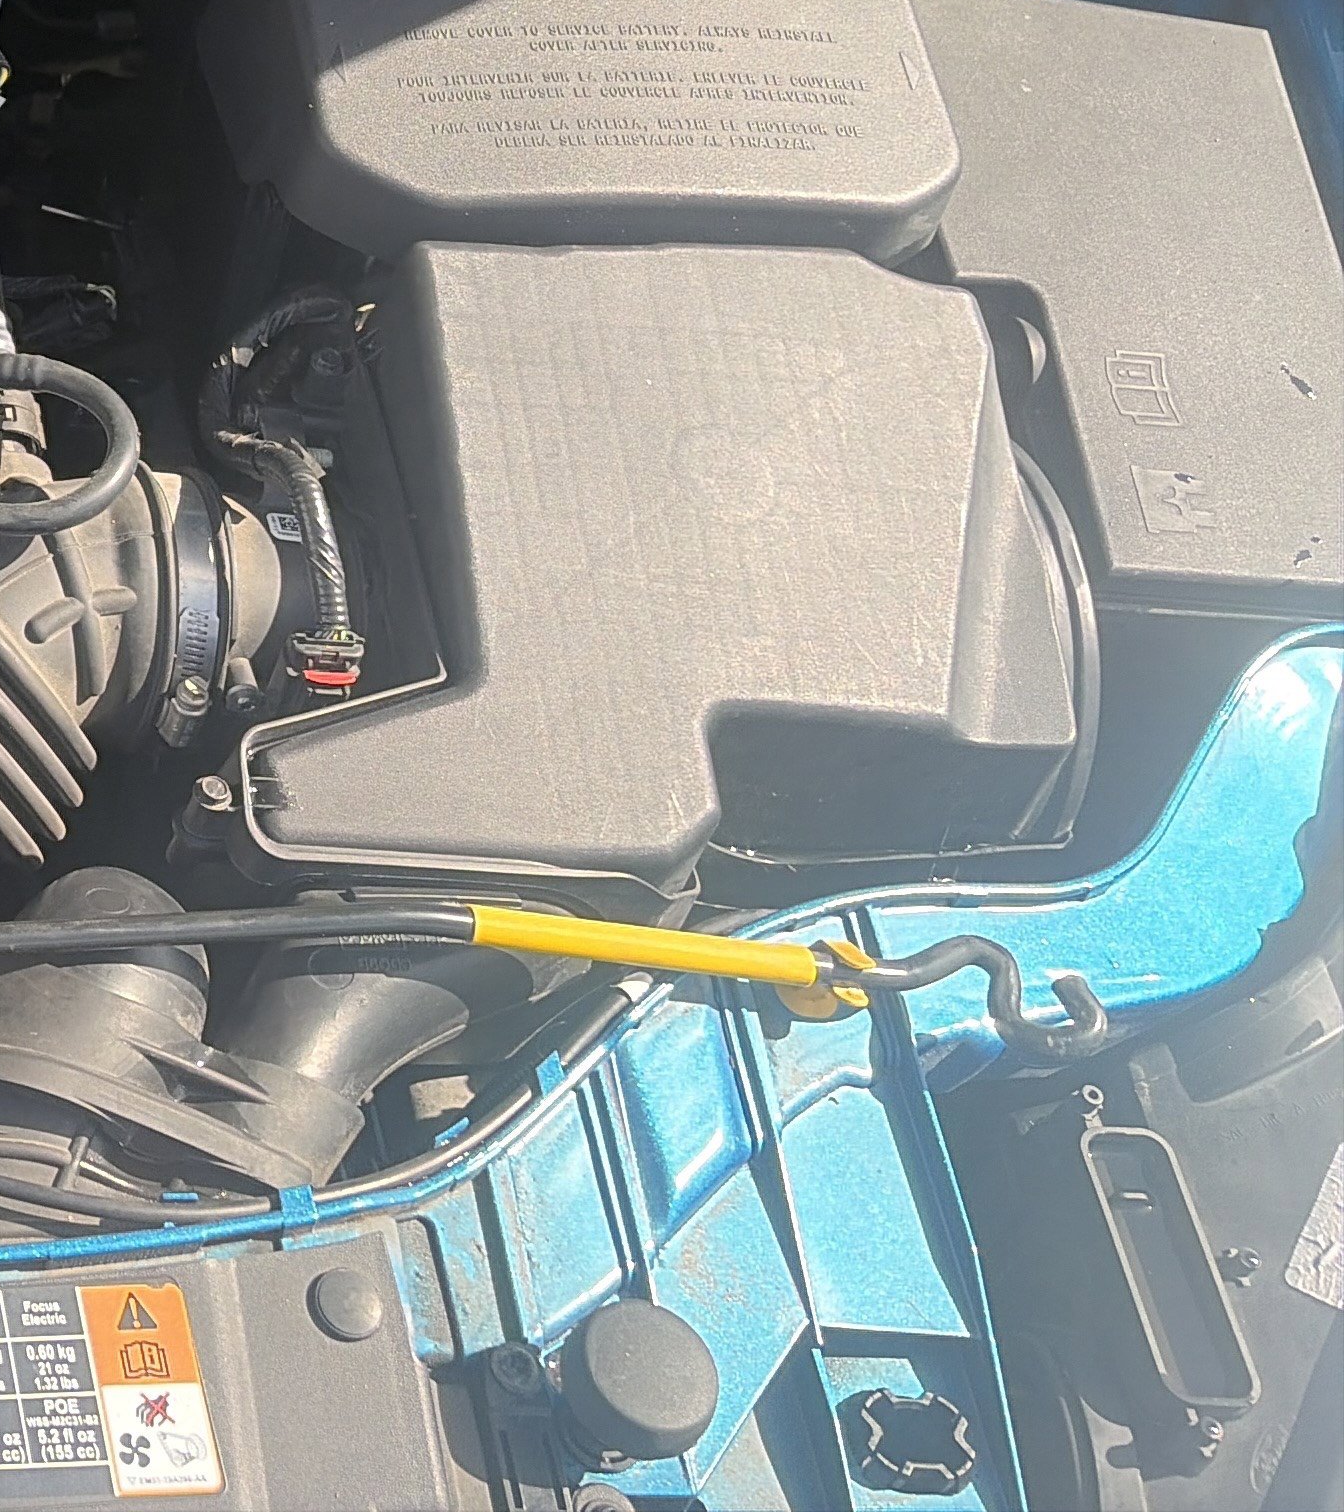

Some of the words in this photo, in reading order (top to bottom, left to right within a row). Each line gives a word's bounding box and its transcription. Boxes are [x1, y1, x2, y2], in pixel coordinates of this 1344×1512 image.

[404, 28, 457, 41] REMOVE
[467, 26, 512, 38] COVER
[520, 25, 539, 36] TO
[548, 24, 607, 36] SERVICE
[698, 25, 750, 38] ALWAYS
[758, 27, 836, 43] REINSTALL
[529, 40, 574, 52] COVER
[583, 40, 628, 51] AFTER
[637, 40, 724, 53] SERVICING.
[397, 75, 434, 88] POUR
[444, 73, 534, 86] INTERVENIR
[542, 72, 570, 83] SUR
[578, 72, 597, 83] LA
[694, 72, 756, 85] ENLEVER
[762, 74, 783, 87] LE
[790, 76, 868, 92] COUVERCLE
[419, 89, 492, 103] TOUJOURS
[501, 87, 564, 100] REPOSER
[573, 88, 592, 98] LE
[600, 87, 681, 99] COUVERCLE
[742, 88, 854, 106] INTERVENTION.
[430, 122, 470, 135] PARA
[477, 119, 541, 132] REVISAR
[550, 119, 569, 131] LA
[657, 118, 712, 131] RETIRE
[720, 120, 741, 131] EL
[747, 120, 828, 135] PROTECTOR
[835, 124, 863, 138] QUE
[558, 135, 585, 146] SER
[595, 134, 694, 146] REINSTALADO
[703, 135, 722, 147] AL
[730, 136, 816, 151] FINALIZAR.
[23, 1301, 60, 1313] Focus
[21, 1313, 67, 1327] Electric
[26, 1345, 55, 1361] 0.60
[57, 1344, 76, 1363] kg
[38, 1363, 52, 1375] 21
[54, 1364, 70, 1375] oz
[34, 1378, 59, 1391] 1.32
[61, 1377, 79, 1390] lbs
[44, 1399, 80, 1414] POE
[3, 1433, 21, 1445] oz
[38, 1429, 60, 1444] 5.2
[63, 1428, 74, 1443] fl
[77, 1430, 96, 1442] oz
[2, 1446, 26, 1463] cc)
[41, 1446, 74, 1463] (155
[78, 1443, 101, 1461] cc)
